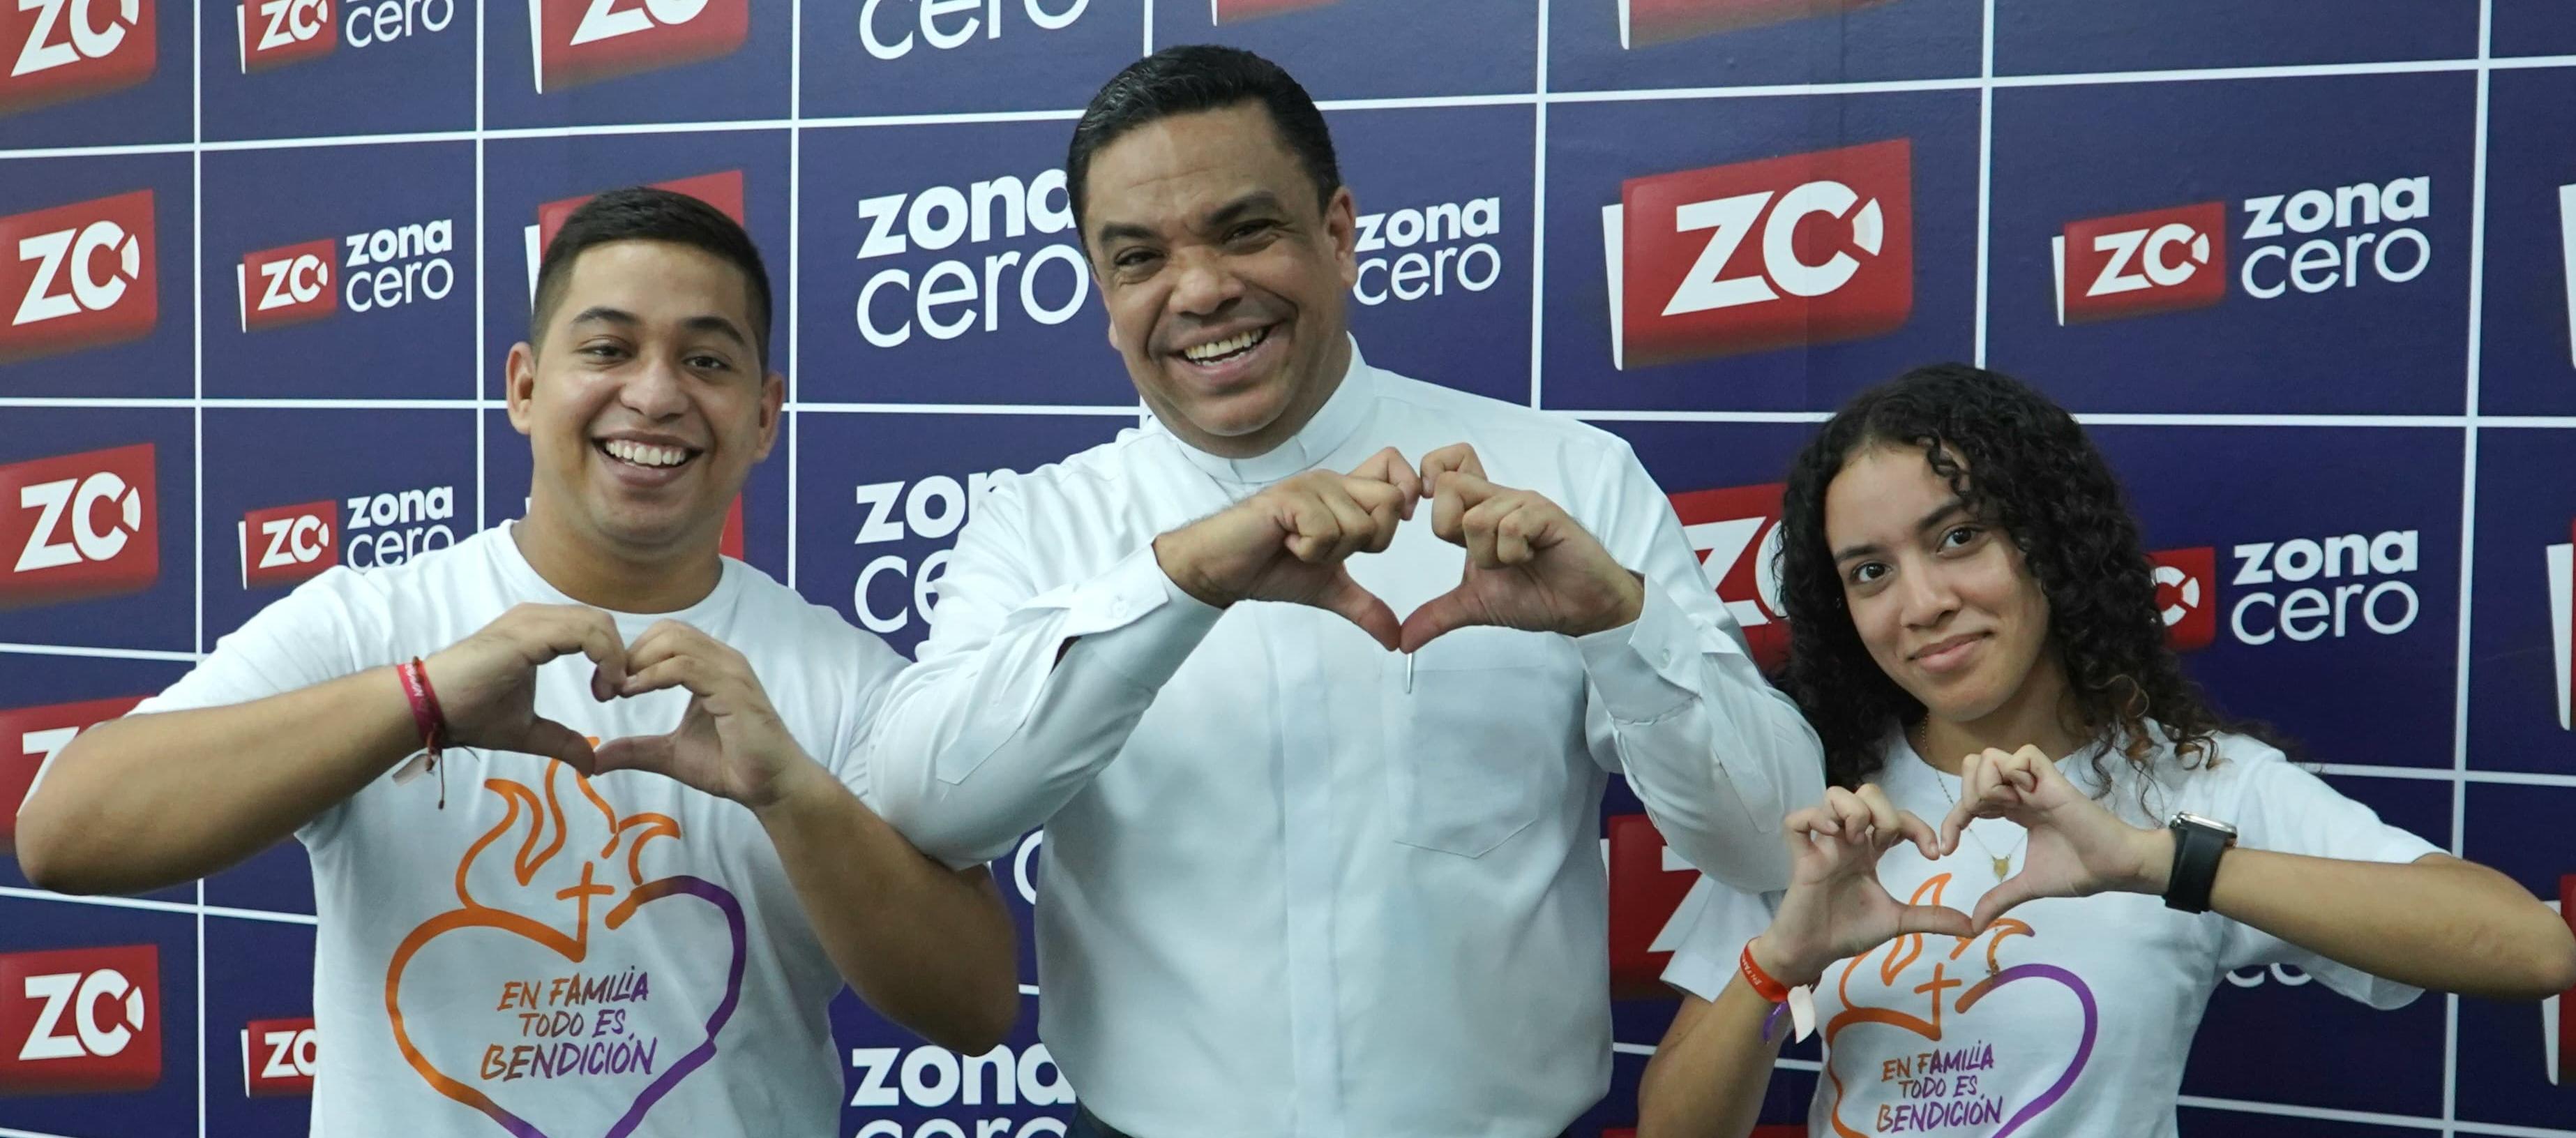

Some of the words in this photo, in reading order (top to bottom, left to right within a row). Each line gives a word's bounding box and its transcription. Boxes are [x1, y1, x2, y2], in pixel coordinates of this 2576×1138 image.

[346, 0, 454, 48] cero
[857, 169, 1077, 260] zona
[1354, 197, 1500, 253] zona
[2242, 176, 2430, 239] zona
[346, 219, 452, 267] zona
[2241, 228, 2431, 299] cero
[345, 257, 454, 313] cero
[857, 244, 1090, 348] cero
[1353, 243, 1501, 306] cero
[347, 486, 453, 530] zona
[347, 524, 455, 574] cero
[2232, 530, 2419, 585] zona
[2231, 581, 2419, 645] cero
[497, 980, 541, 1012] EN
[519, 1010, 585, 1038] TODO
[592, 1008, 626, 1038] ES
[481, 1032, 658, 1082] BENDICIÓN
[850, 1043, 1077, 1108] zona
[1881, 1056, 1911, 1083] EN
[1898, 1076, 1947, 1099] TODO
[1953, 1075, 1978, 1098] ES
[1876, 1093, 2003, 1134] BENDICIÓN
